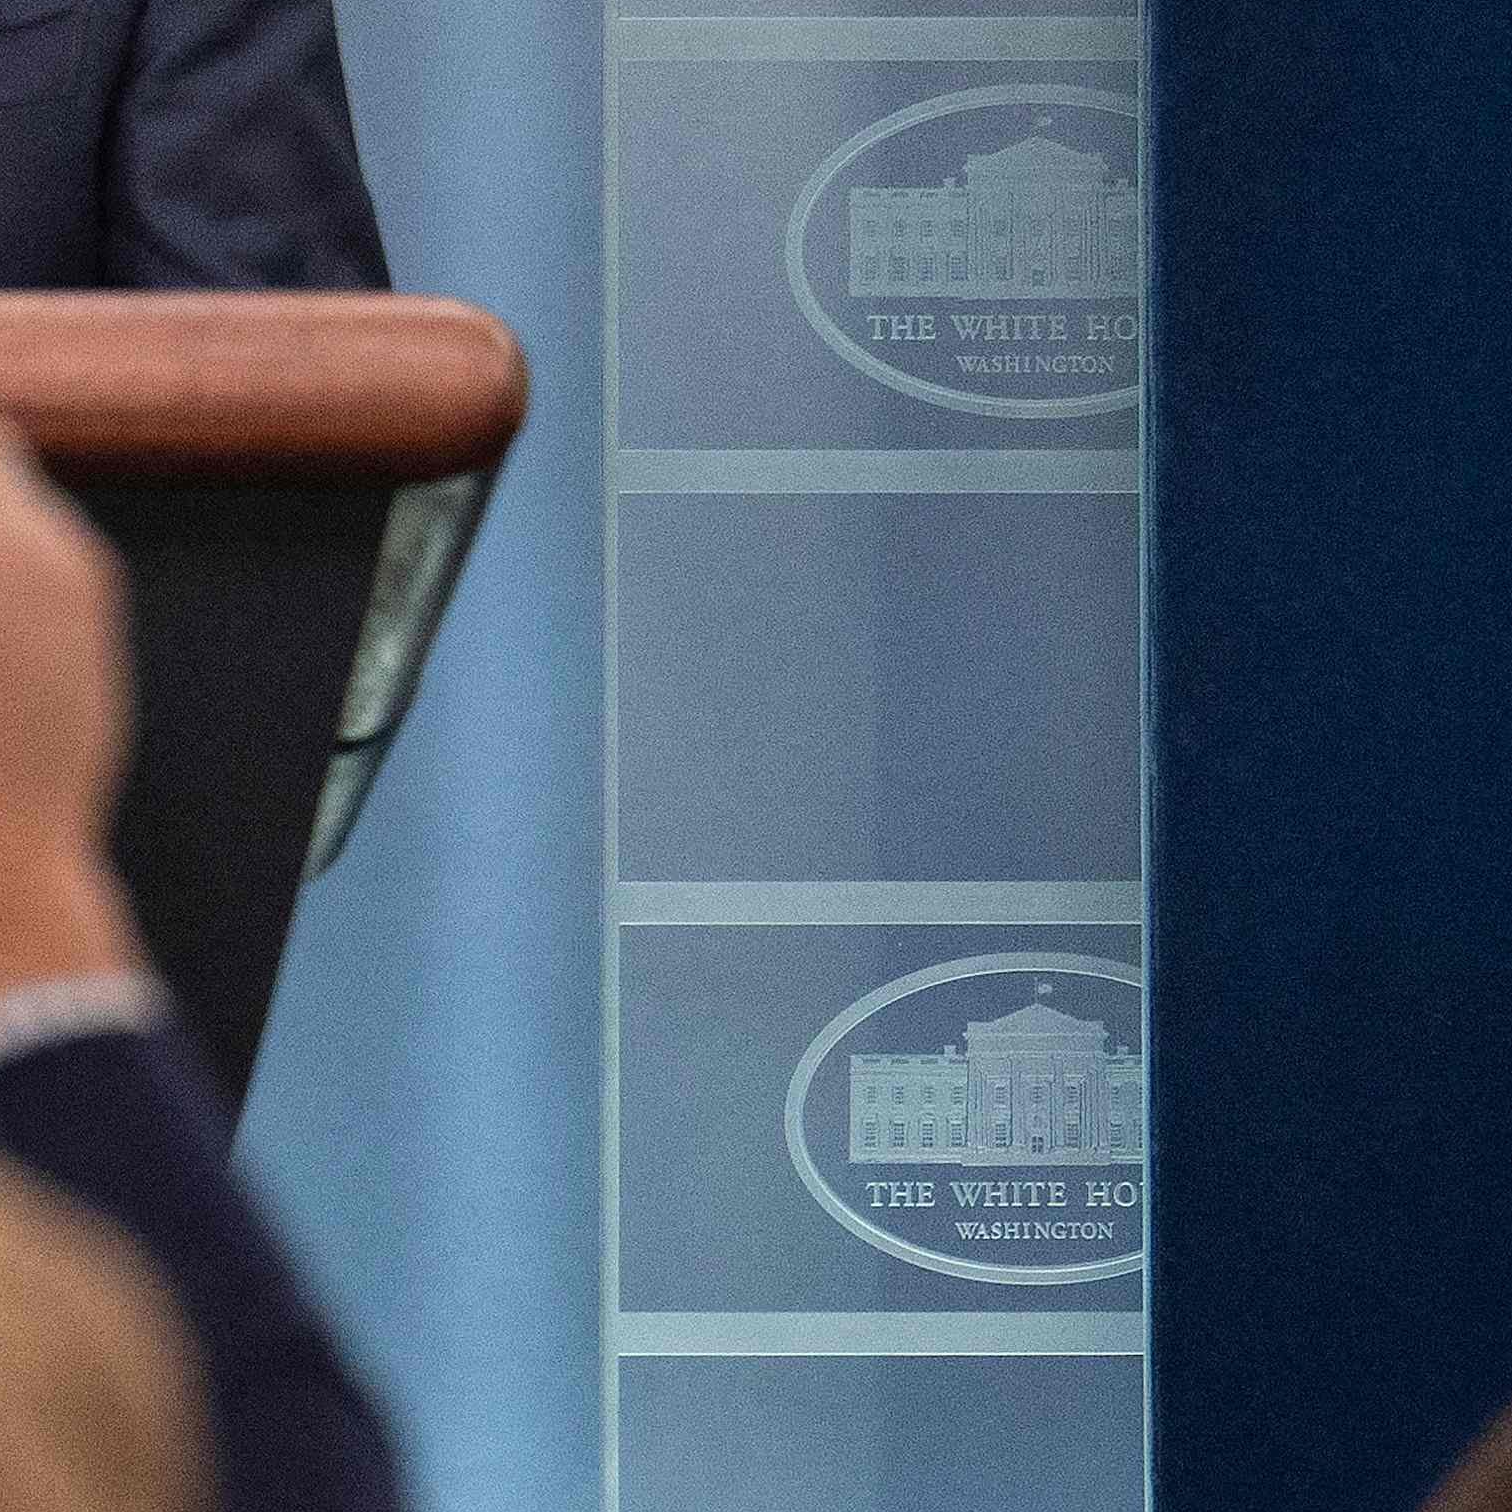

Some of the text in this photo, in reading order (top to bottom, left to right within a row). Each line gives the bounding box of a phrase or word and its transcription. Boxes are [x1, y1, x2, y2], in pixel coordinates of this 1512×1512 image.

[867, 314, 936, 341] THE
[950, 314, 1068, 341] WHITE
[955, 355, 1116, 375] WASHINGTON
[865, 1181, 1143, 1208] THE WHITE HO
[954, 1222, 1115, 1241] WASHINGTON
